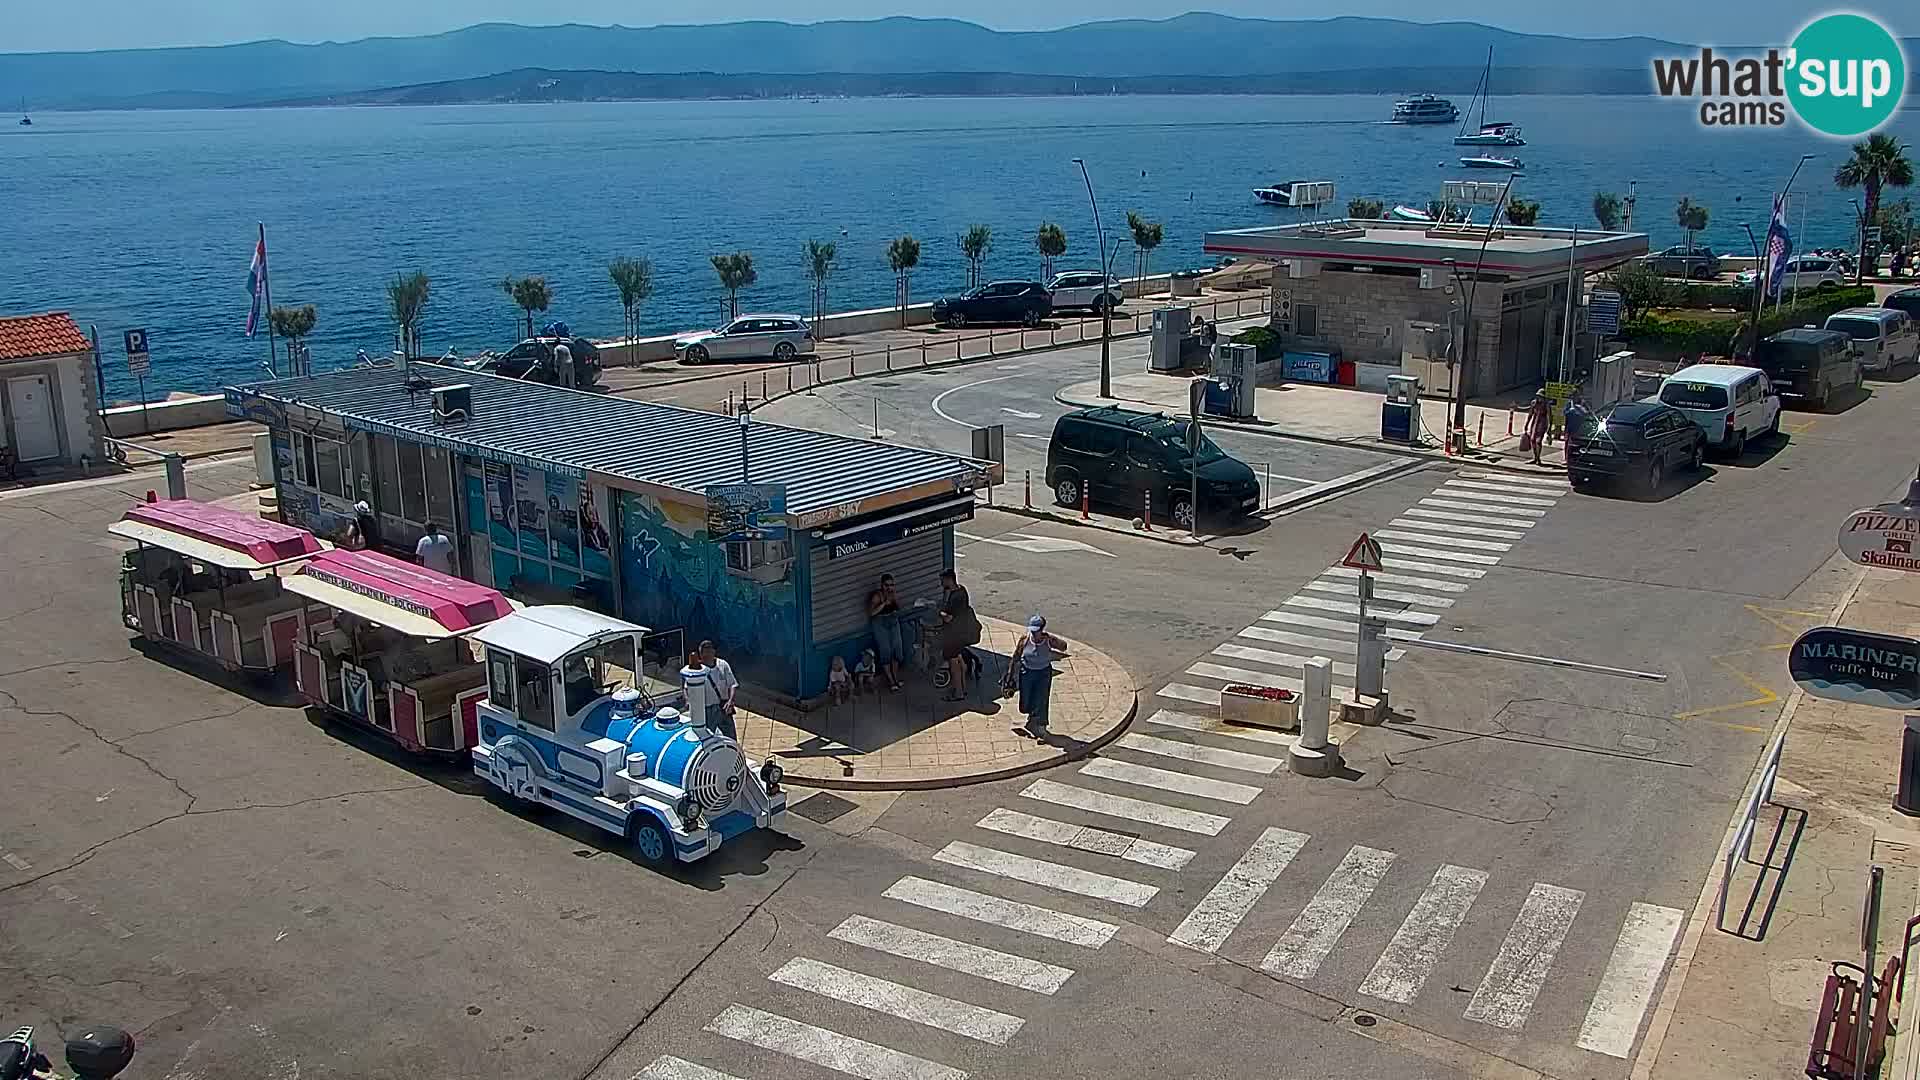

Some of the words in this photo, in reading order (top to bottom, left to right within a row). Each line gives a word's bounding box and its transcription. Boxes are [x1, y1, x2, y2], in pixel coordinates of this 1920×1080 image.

[1687, 383, 1706, 392] TAXI
[436, 437, 467, 453] POSTAJA
[478, 447, 493, 458] BUS
[494, 451, 527, 466] STATION
[527, 457, 554, 473] TICKET
[555, 463, 583, 478] OFFICE
[1848, 516, 1920, 533] PIZZE
[1800, 643, 1920, 674] MARINER
[1829, 663, 1866, 675] caffe
[1871, 666, 1898, 681] bar
